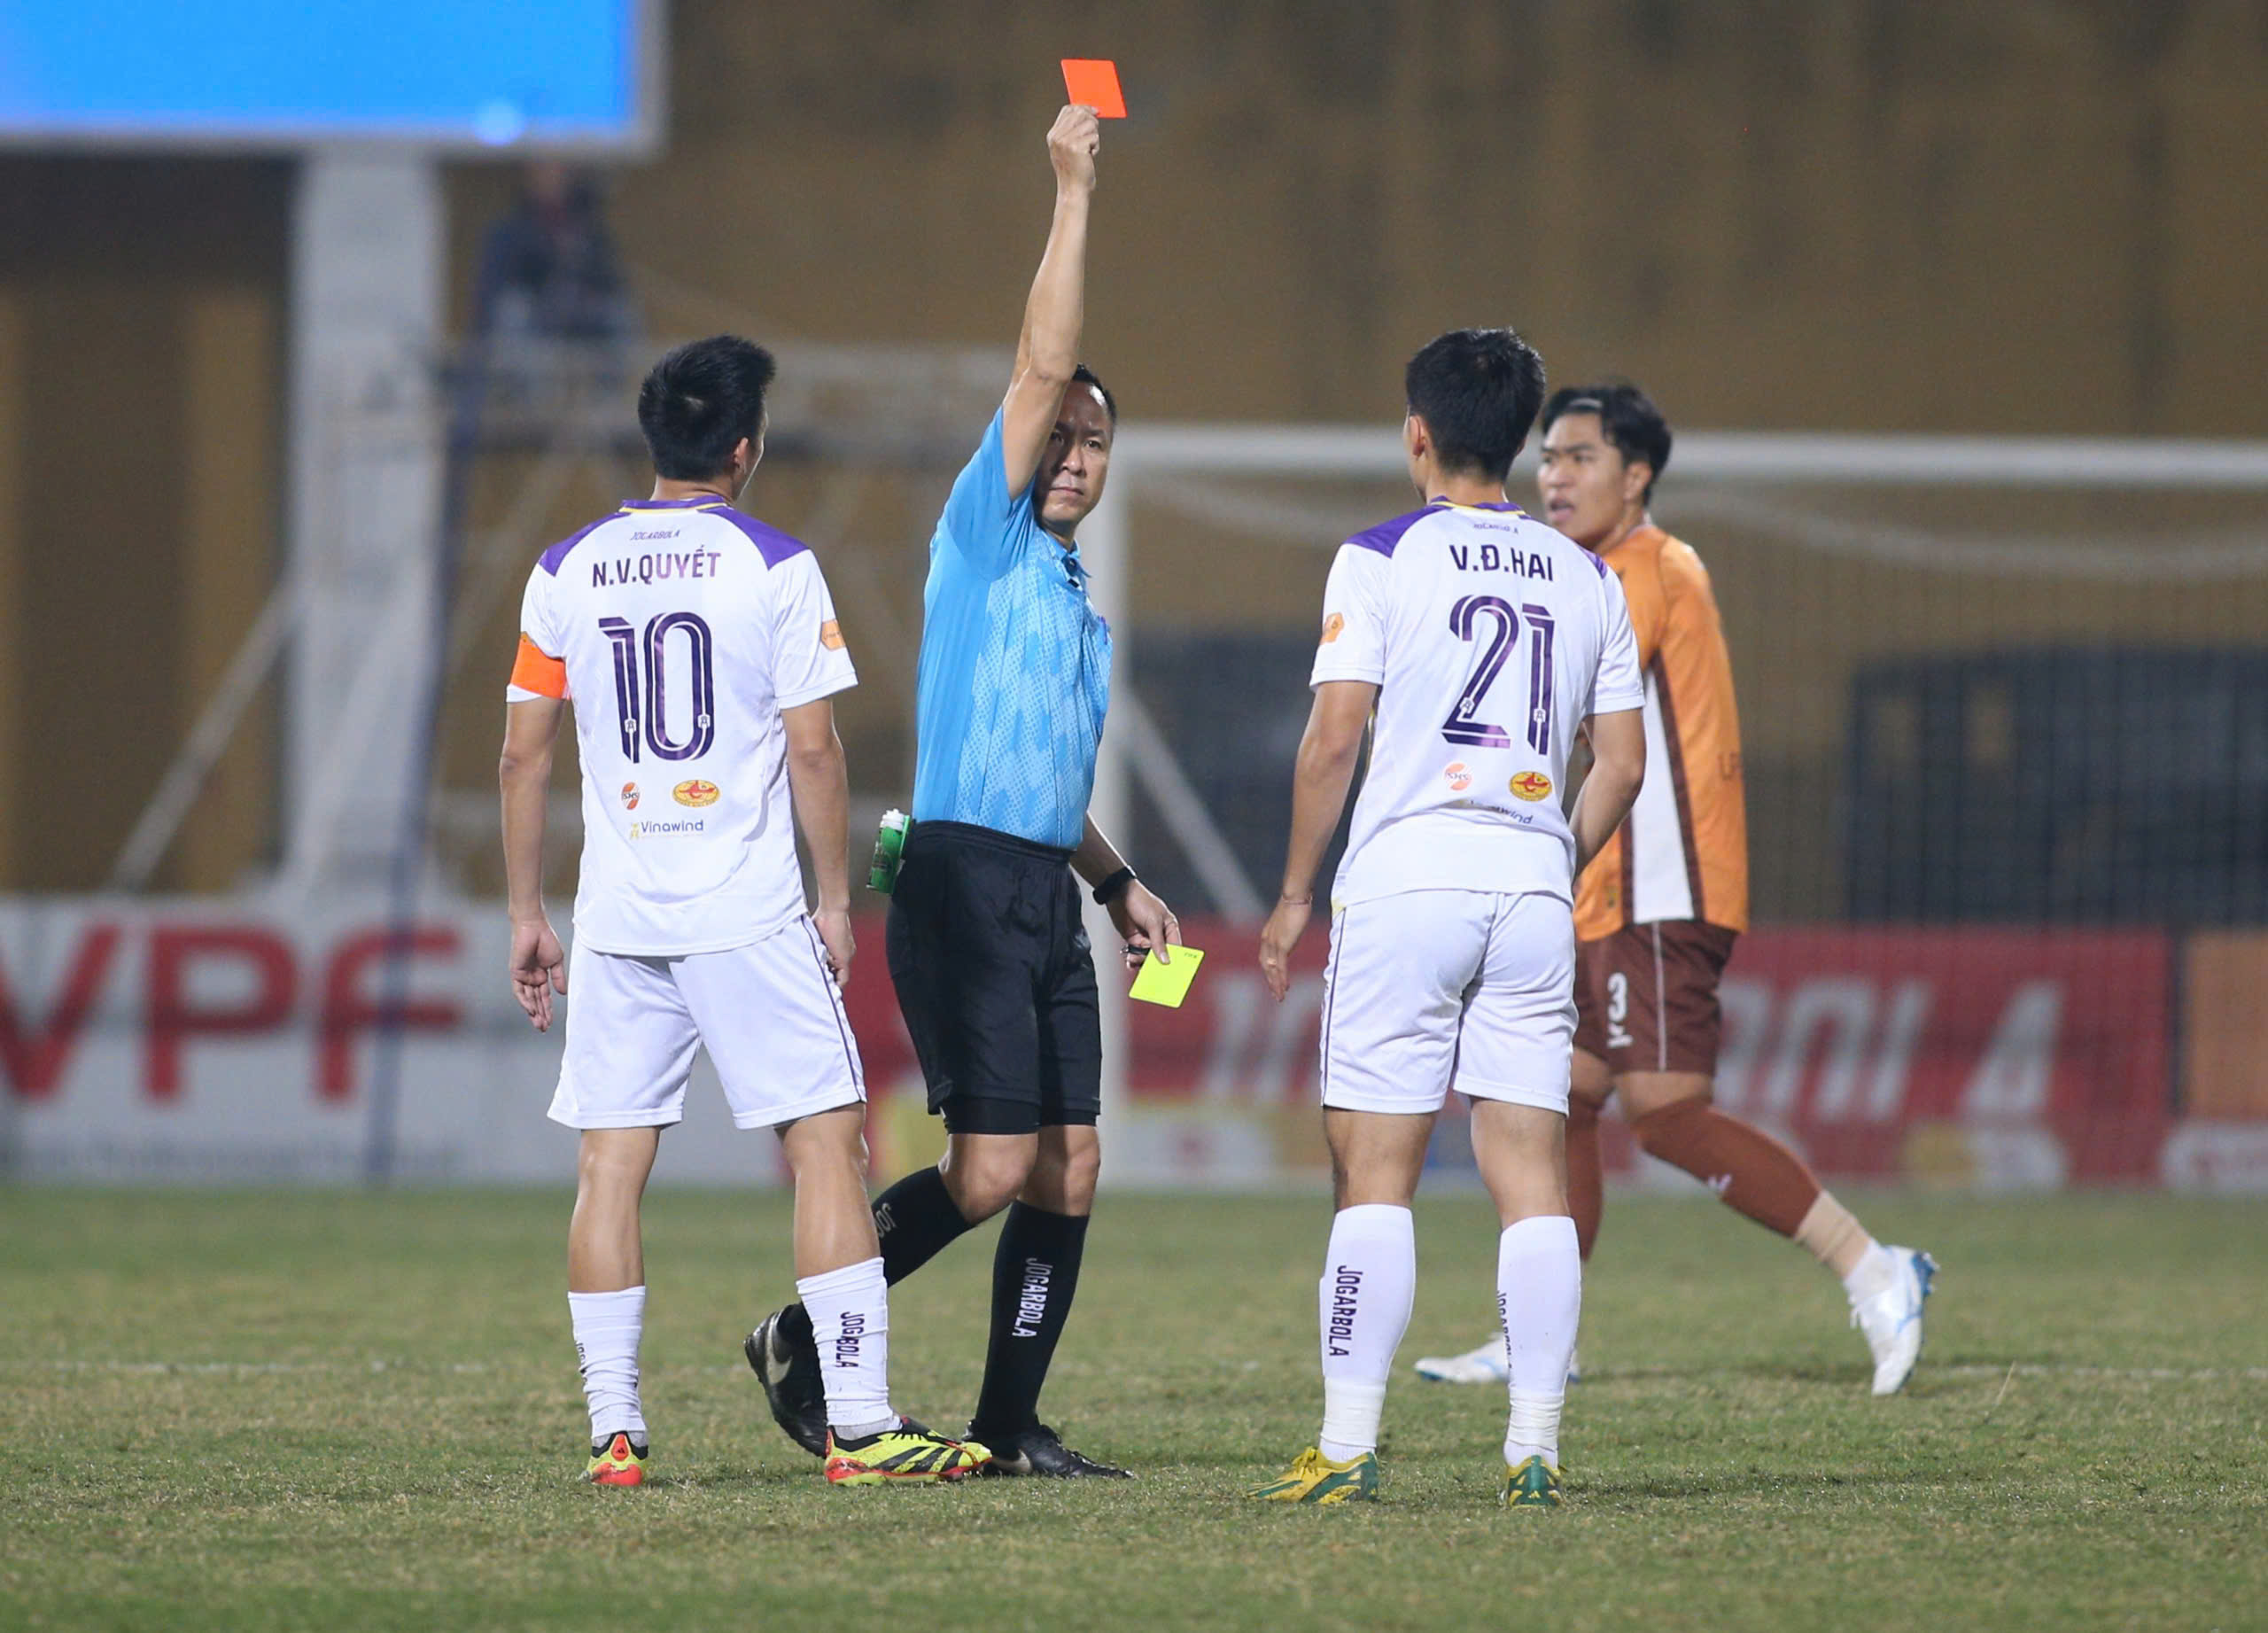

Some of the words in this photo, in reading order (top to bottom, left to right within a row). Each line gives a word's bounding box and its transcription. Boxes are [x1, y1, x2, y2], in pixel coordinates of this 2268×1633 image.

[592, 544, 721, 587] N.V.QUYẾT
[1449, 544, 1553, 581] V.Đ.HAI
[598, 611, 715, 764] 10
[1441, 595, 1555, 756] 21
[641, 819, 704, 833] Vinawind
[0, 922, 464, 1103] VPF
[1607, 972, 1627, 1022] 3
[1012, 1257, 1053, 1337] JOGARBOLA
[1329, 1264, 1363, 1357] JOGARBOLA
